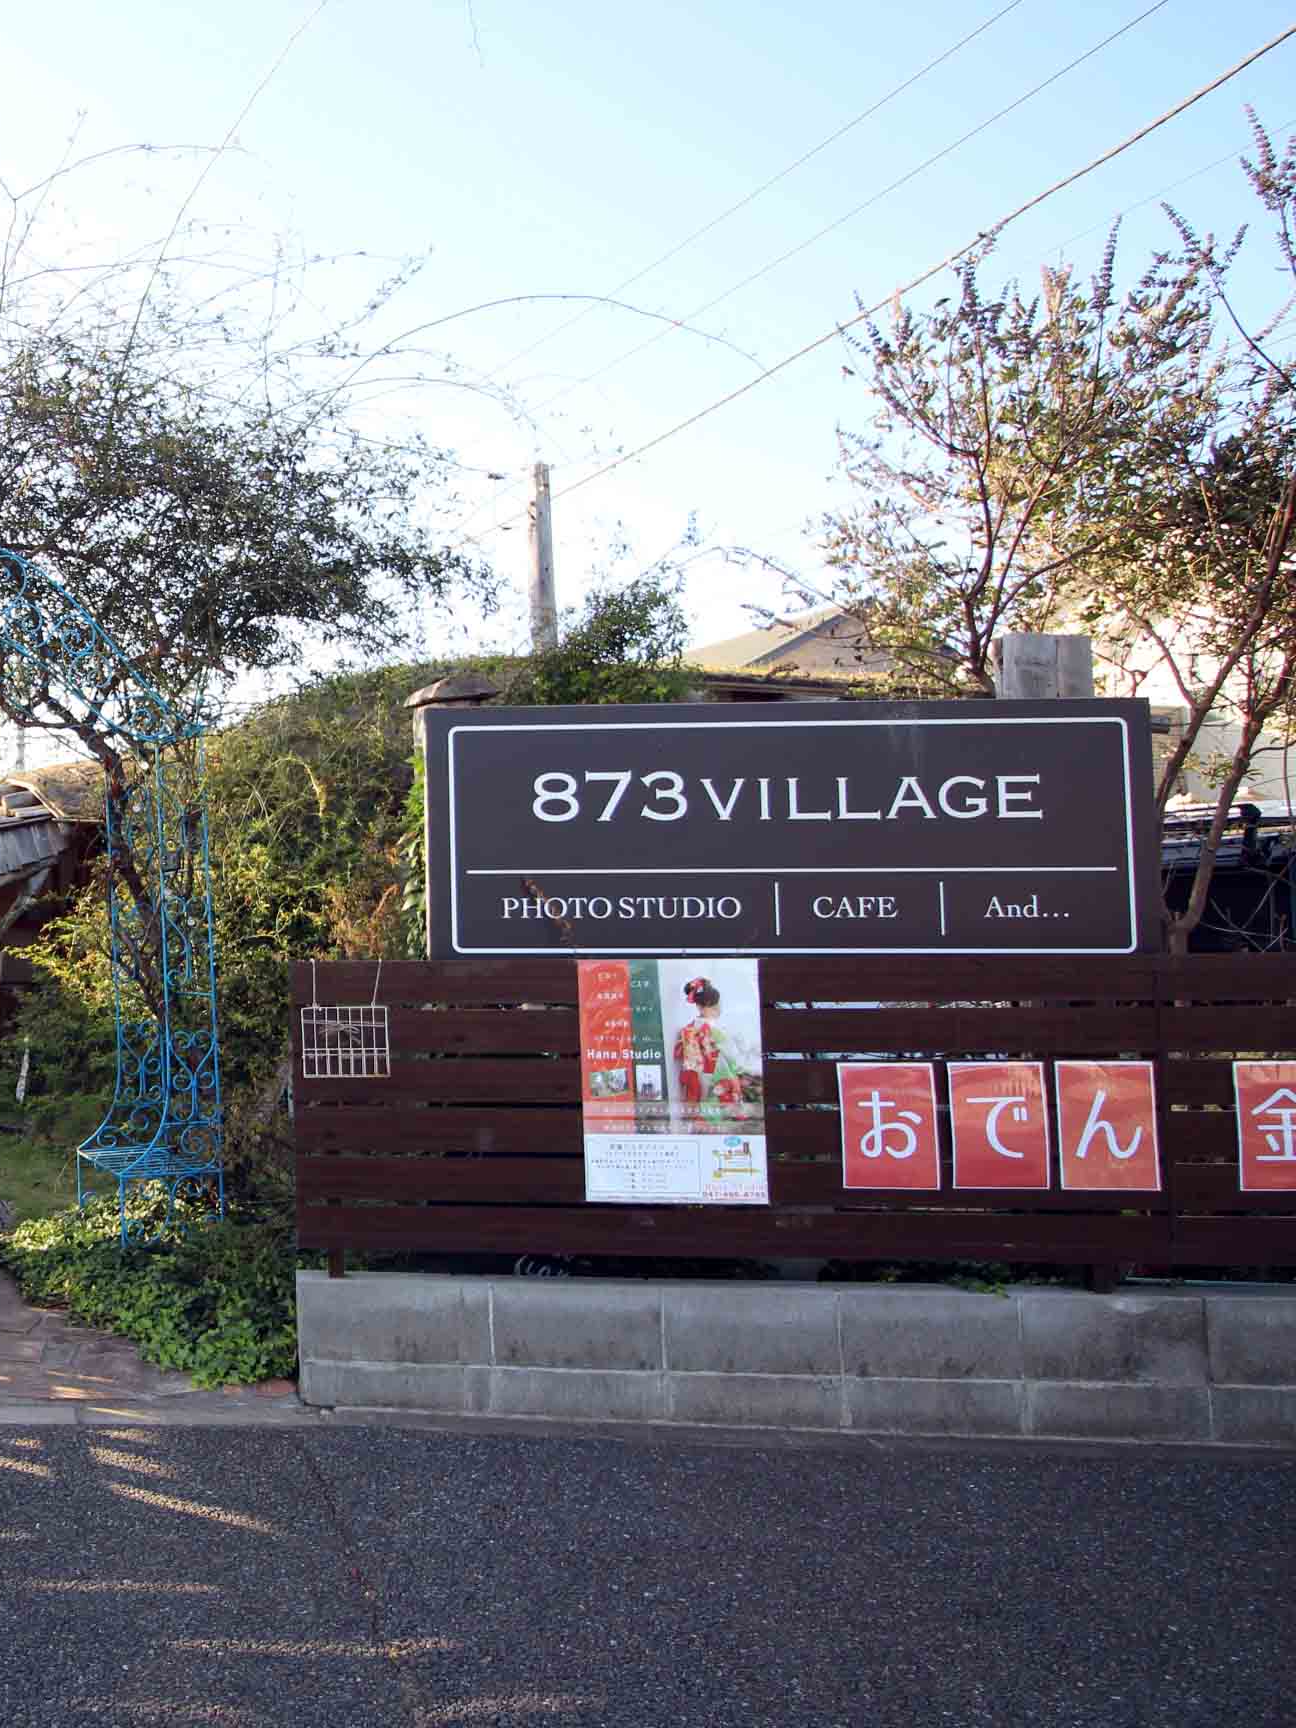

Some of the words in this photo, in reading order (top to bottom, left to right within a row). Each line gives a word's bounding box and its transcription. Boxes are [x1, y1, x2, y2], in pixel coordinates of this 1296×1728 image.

[502, 896, 613, 920] PHOTO
[618, 896, 742, 919] STUDIO
[812, 896, 898, 919] CAFE
[586, 1048, 617, 1060] Hana
[622, 1047, 662, 1060] Studio
[857, 1089, 1143, 1160] おでん
